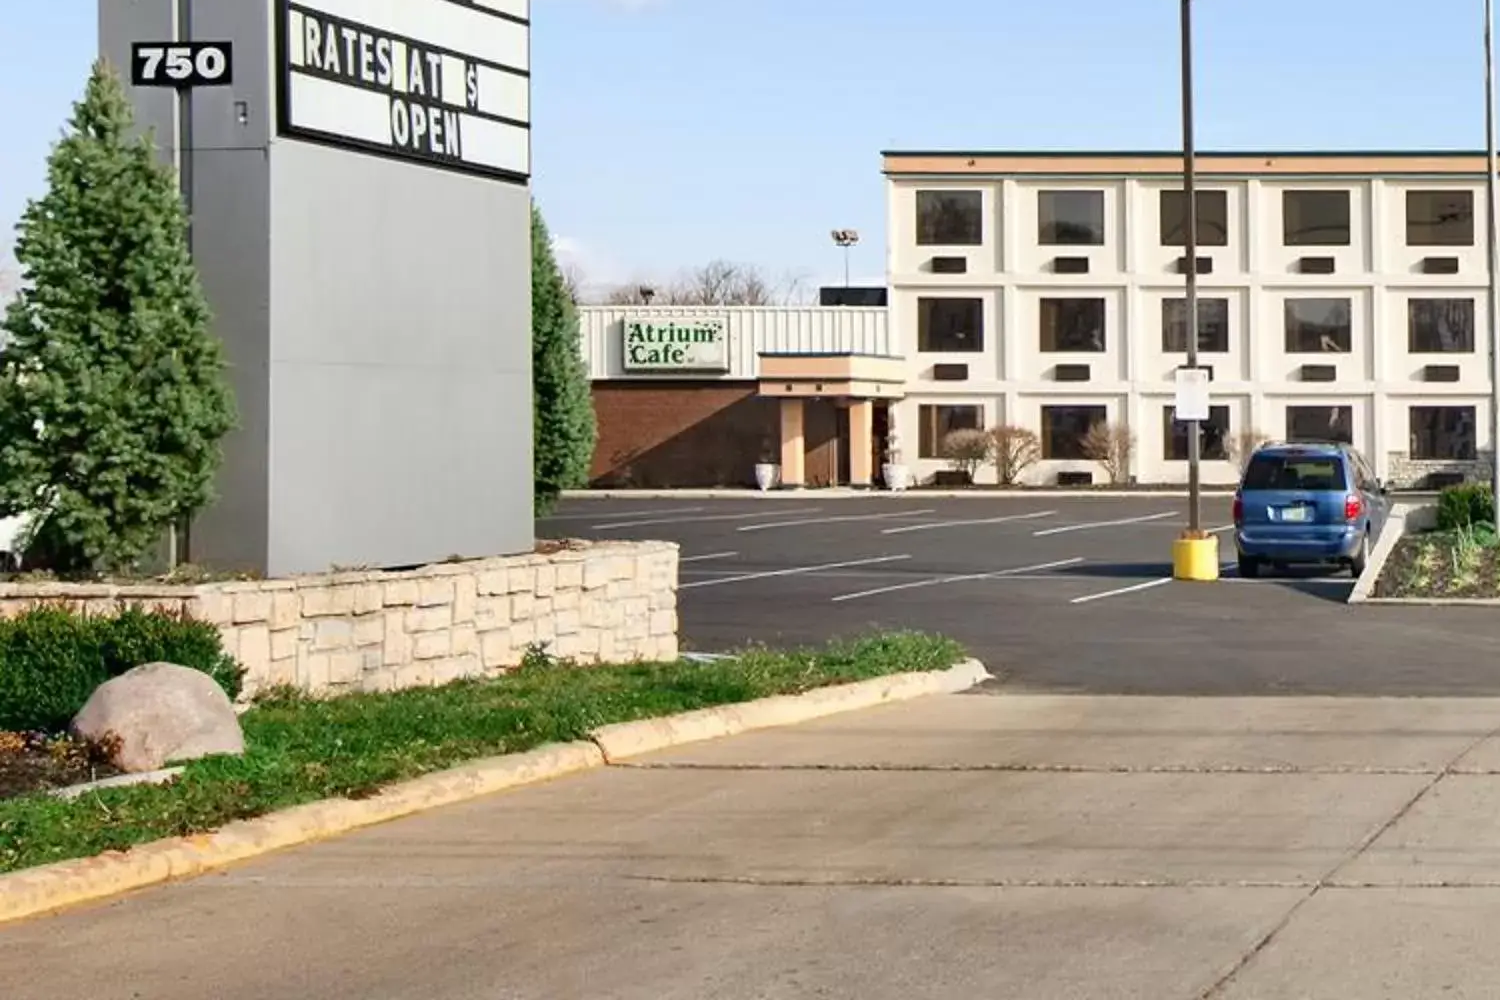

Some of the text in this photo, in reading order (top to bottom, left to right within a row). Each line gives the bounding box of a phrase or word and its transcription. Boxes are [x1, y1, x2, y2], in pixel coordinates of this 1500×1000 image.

[138, 48, 226, 79] 750
[305, 16, 393, 86] RATES
[409, 48, 441, 98] AT
[391, 99, 460, 157] OPEN
[628, 322, 714, 343] Atrium
